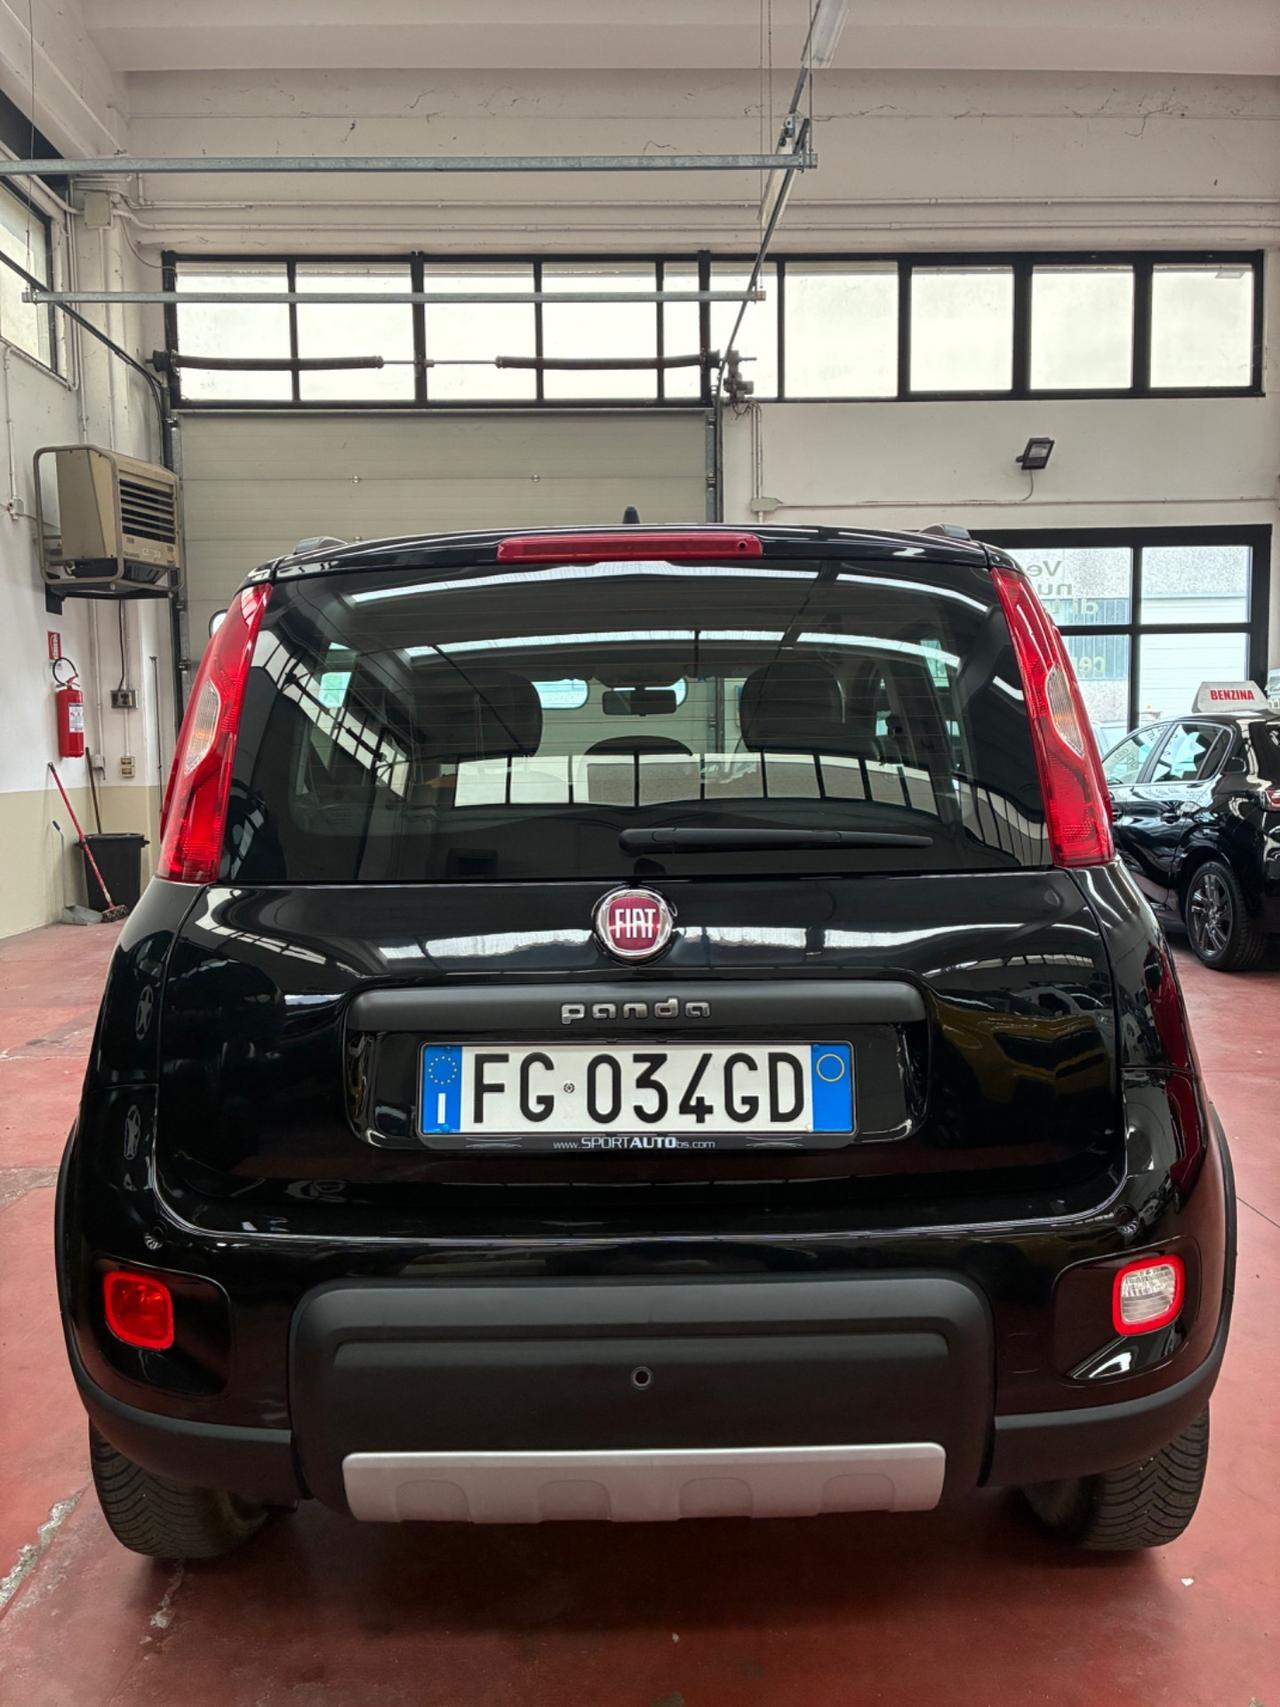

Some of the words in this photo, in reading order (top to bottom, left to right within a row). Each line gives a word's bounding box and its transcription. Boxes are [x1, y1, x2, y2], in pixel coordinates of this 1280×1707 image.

[1210, 689, 1255, 701] BENZINA
[614, 908, 656, 939] FIAT
[561, 998, 711, 1025] panda
